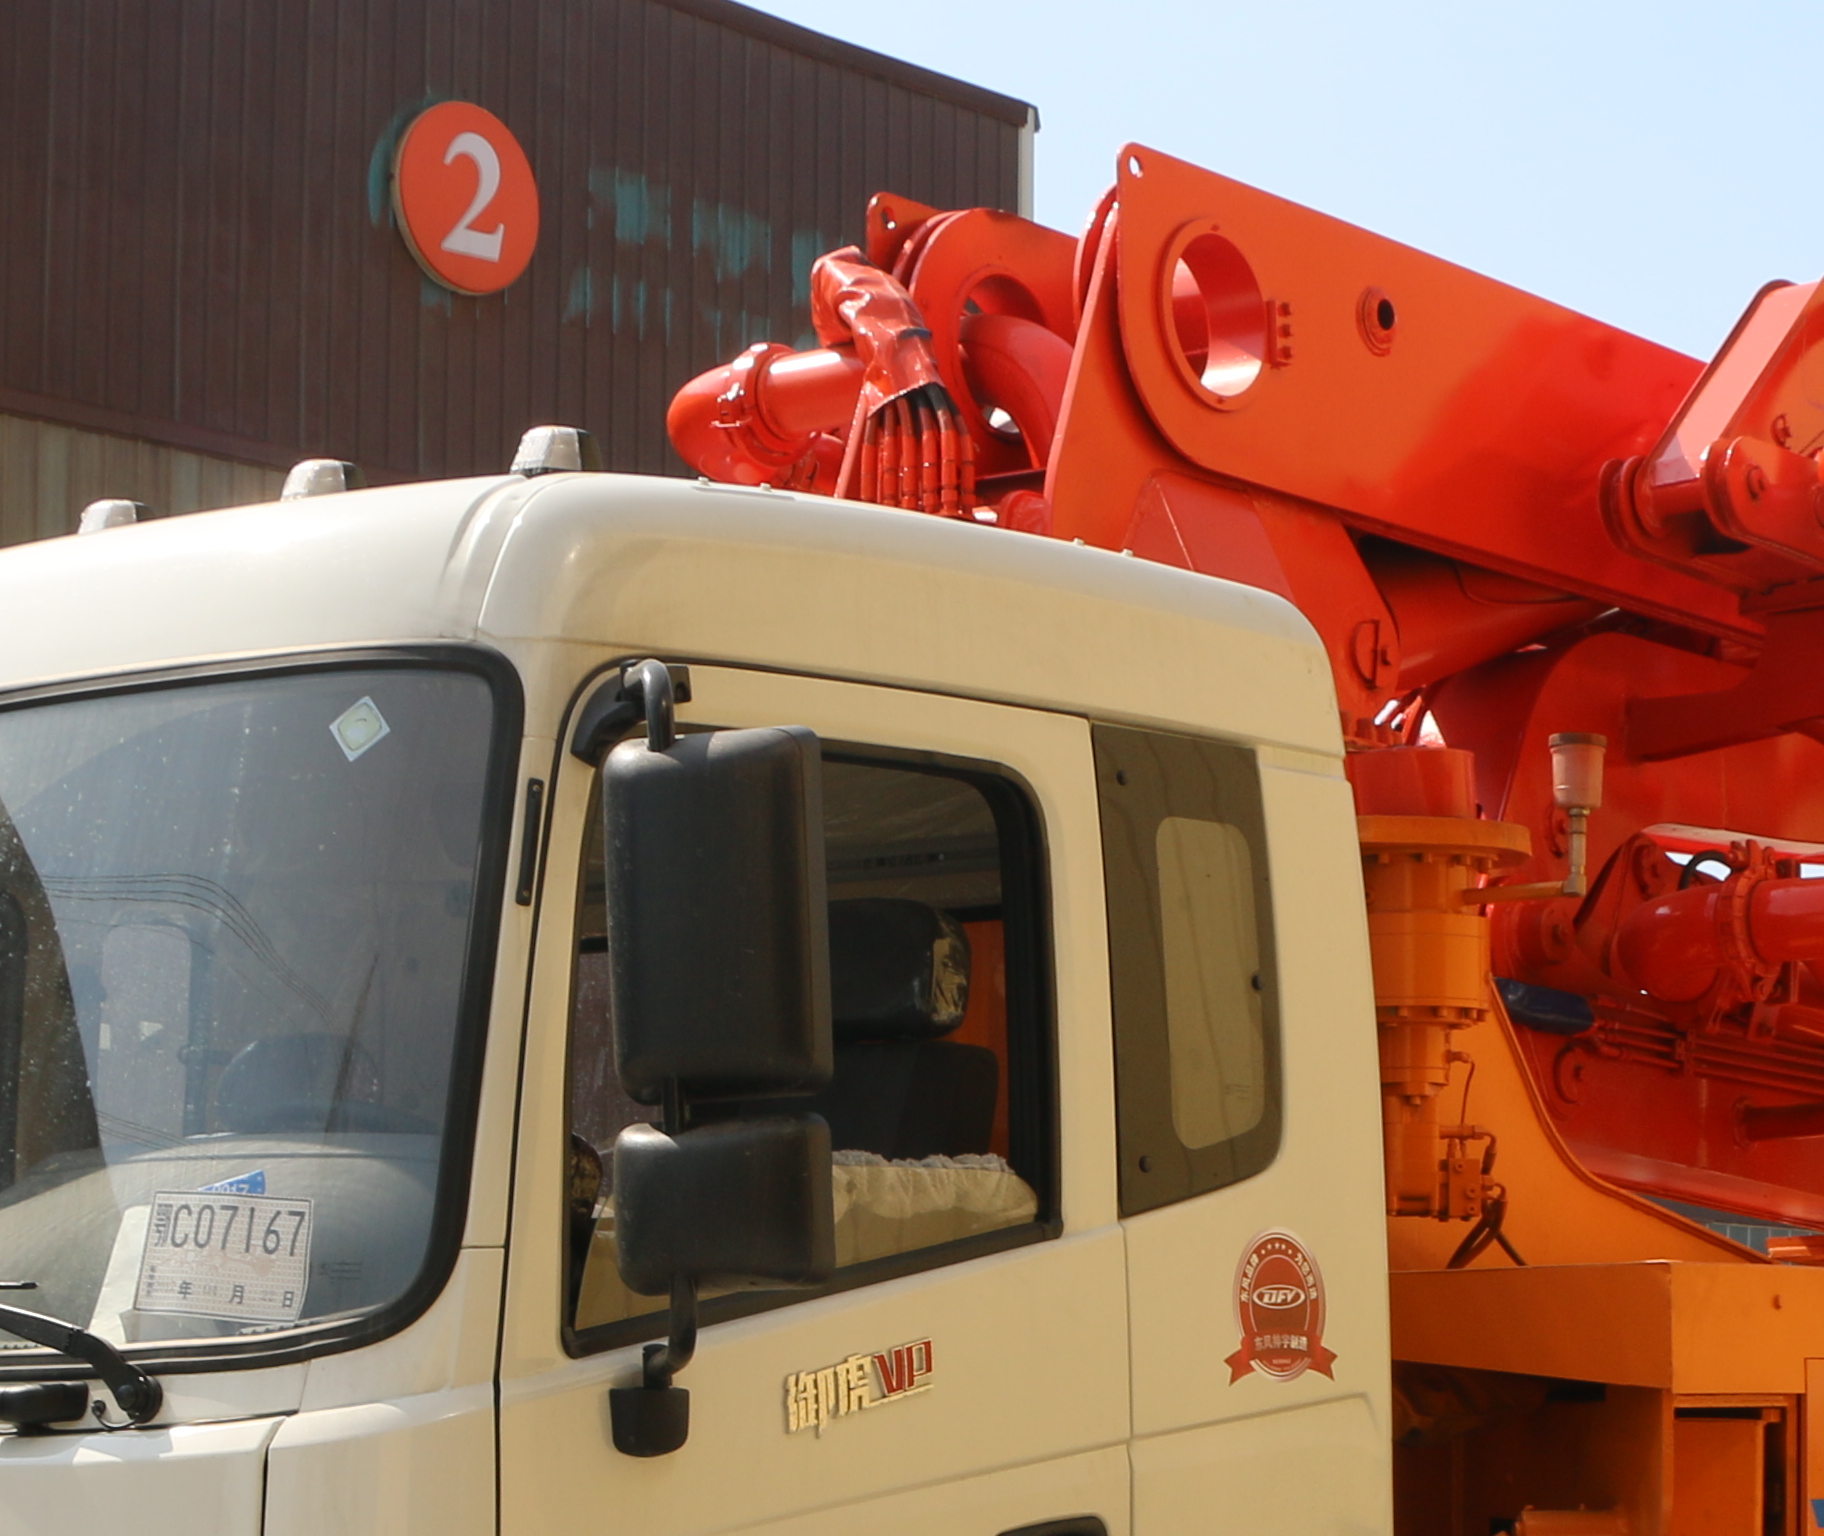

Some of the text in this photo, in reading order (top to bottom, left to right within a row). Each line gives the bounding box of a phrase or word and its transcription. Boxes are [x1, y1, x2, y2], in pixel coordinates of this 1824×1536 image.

[441, 131, 505, 264] 2
[228, 1284, 245, 1304] 月
[282, 1291, 295, 1308] 日
